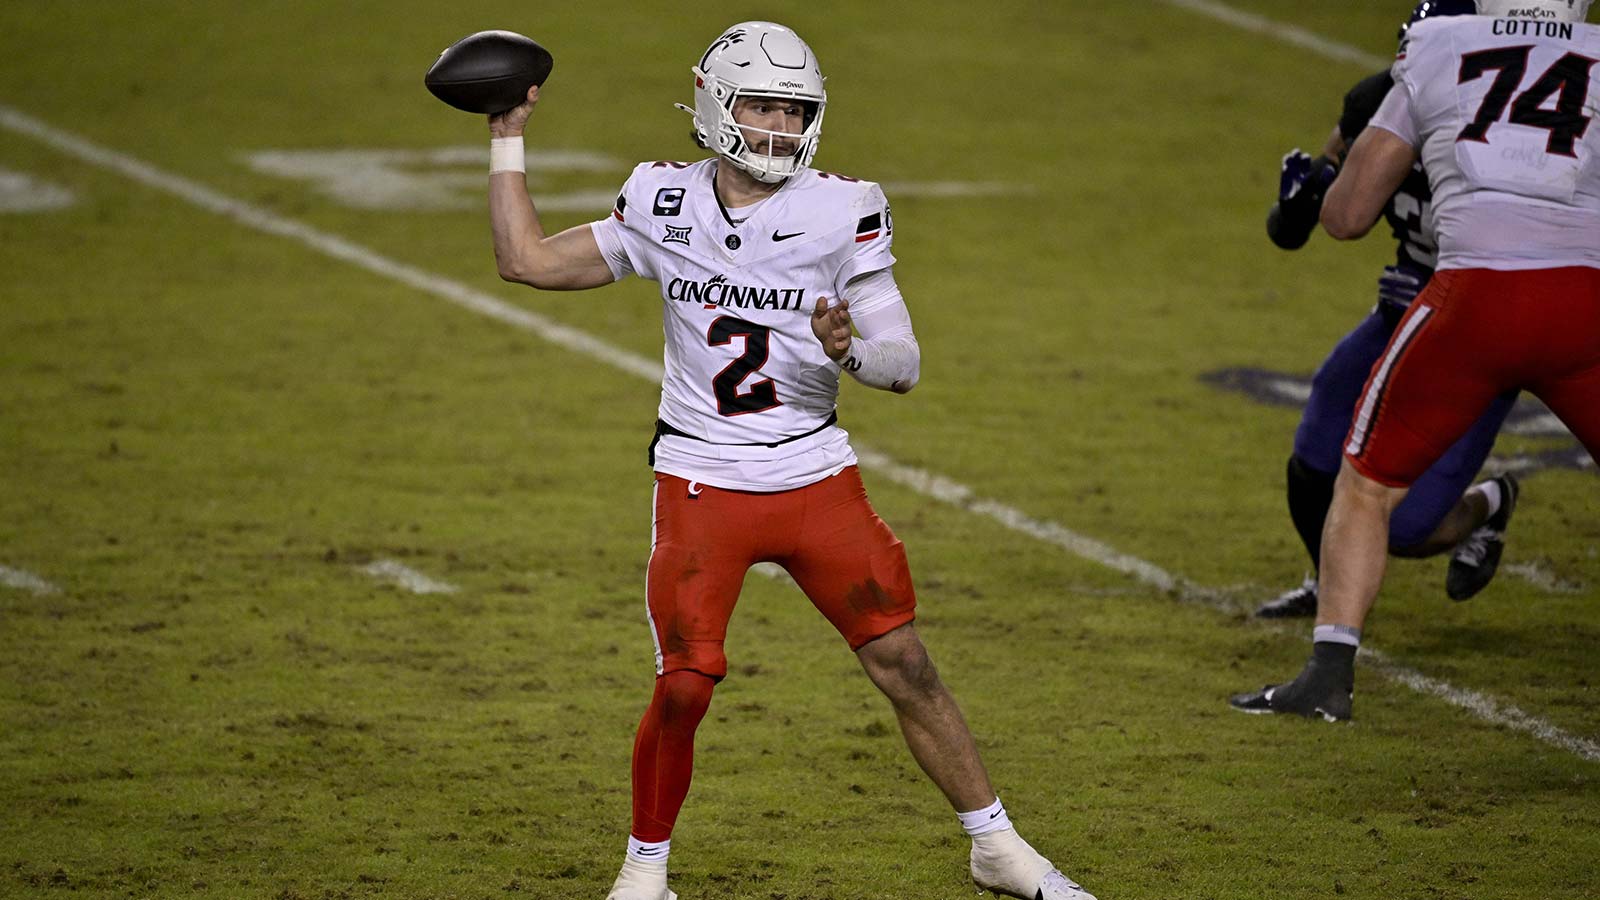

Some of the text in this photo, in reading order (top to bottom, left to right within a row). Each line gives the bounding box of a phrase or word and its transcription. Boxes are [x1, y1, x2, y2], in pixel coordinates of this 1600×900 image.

[1507, 7, 1556, 19] BEARCATS
[1492, 19, 1573, 41] COTTON
[1455, 45, 1600, 159] 74
[657, 189, 682, 208] C
[667, 274, 805, 310] CINCINNATI
[707, 315, 784, 417] 2
